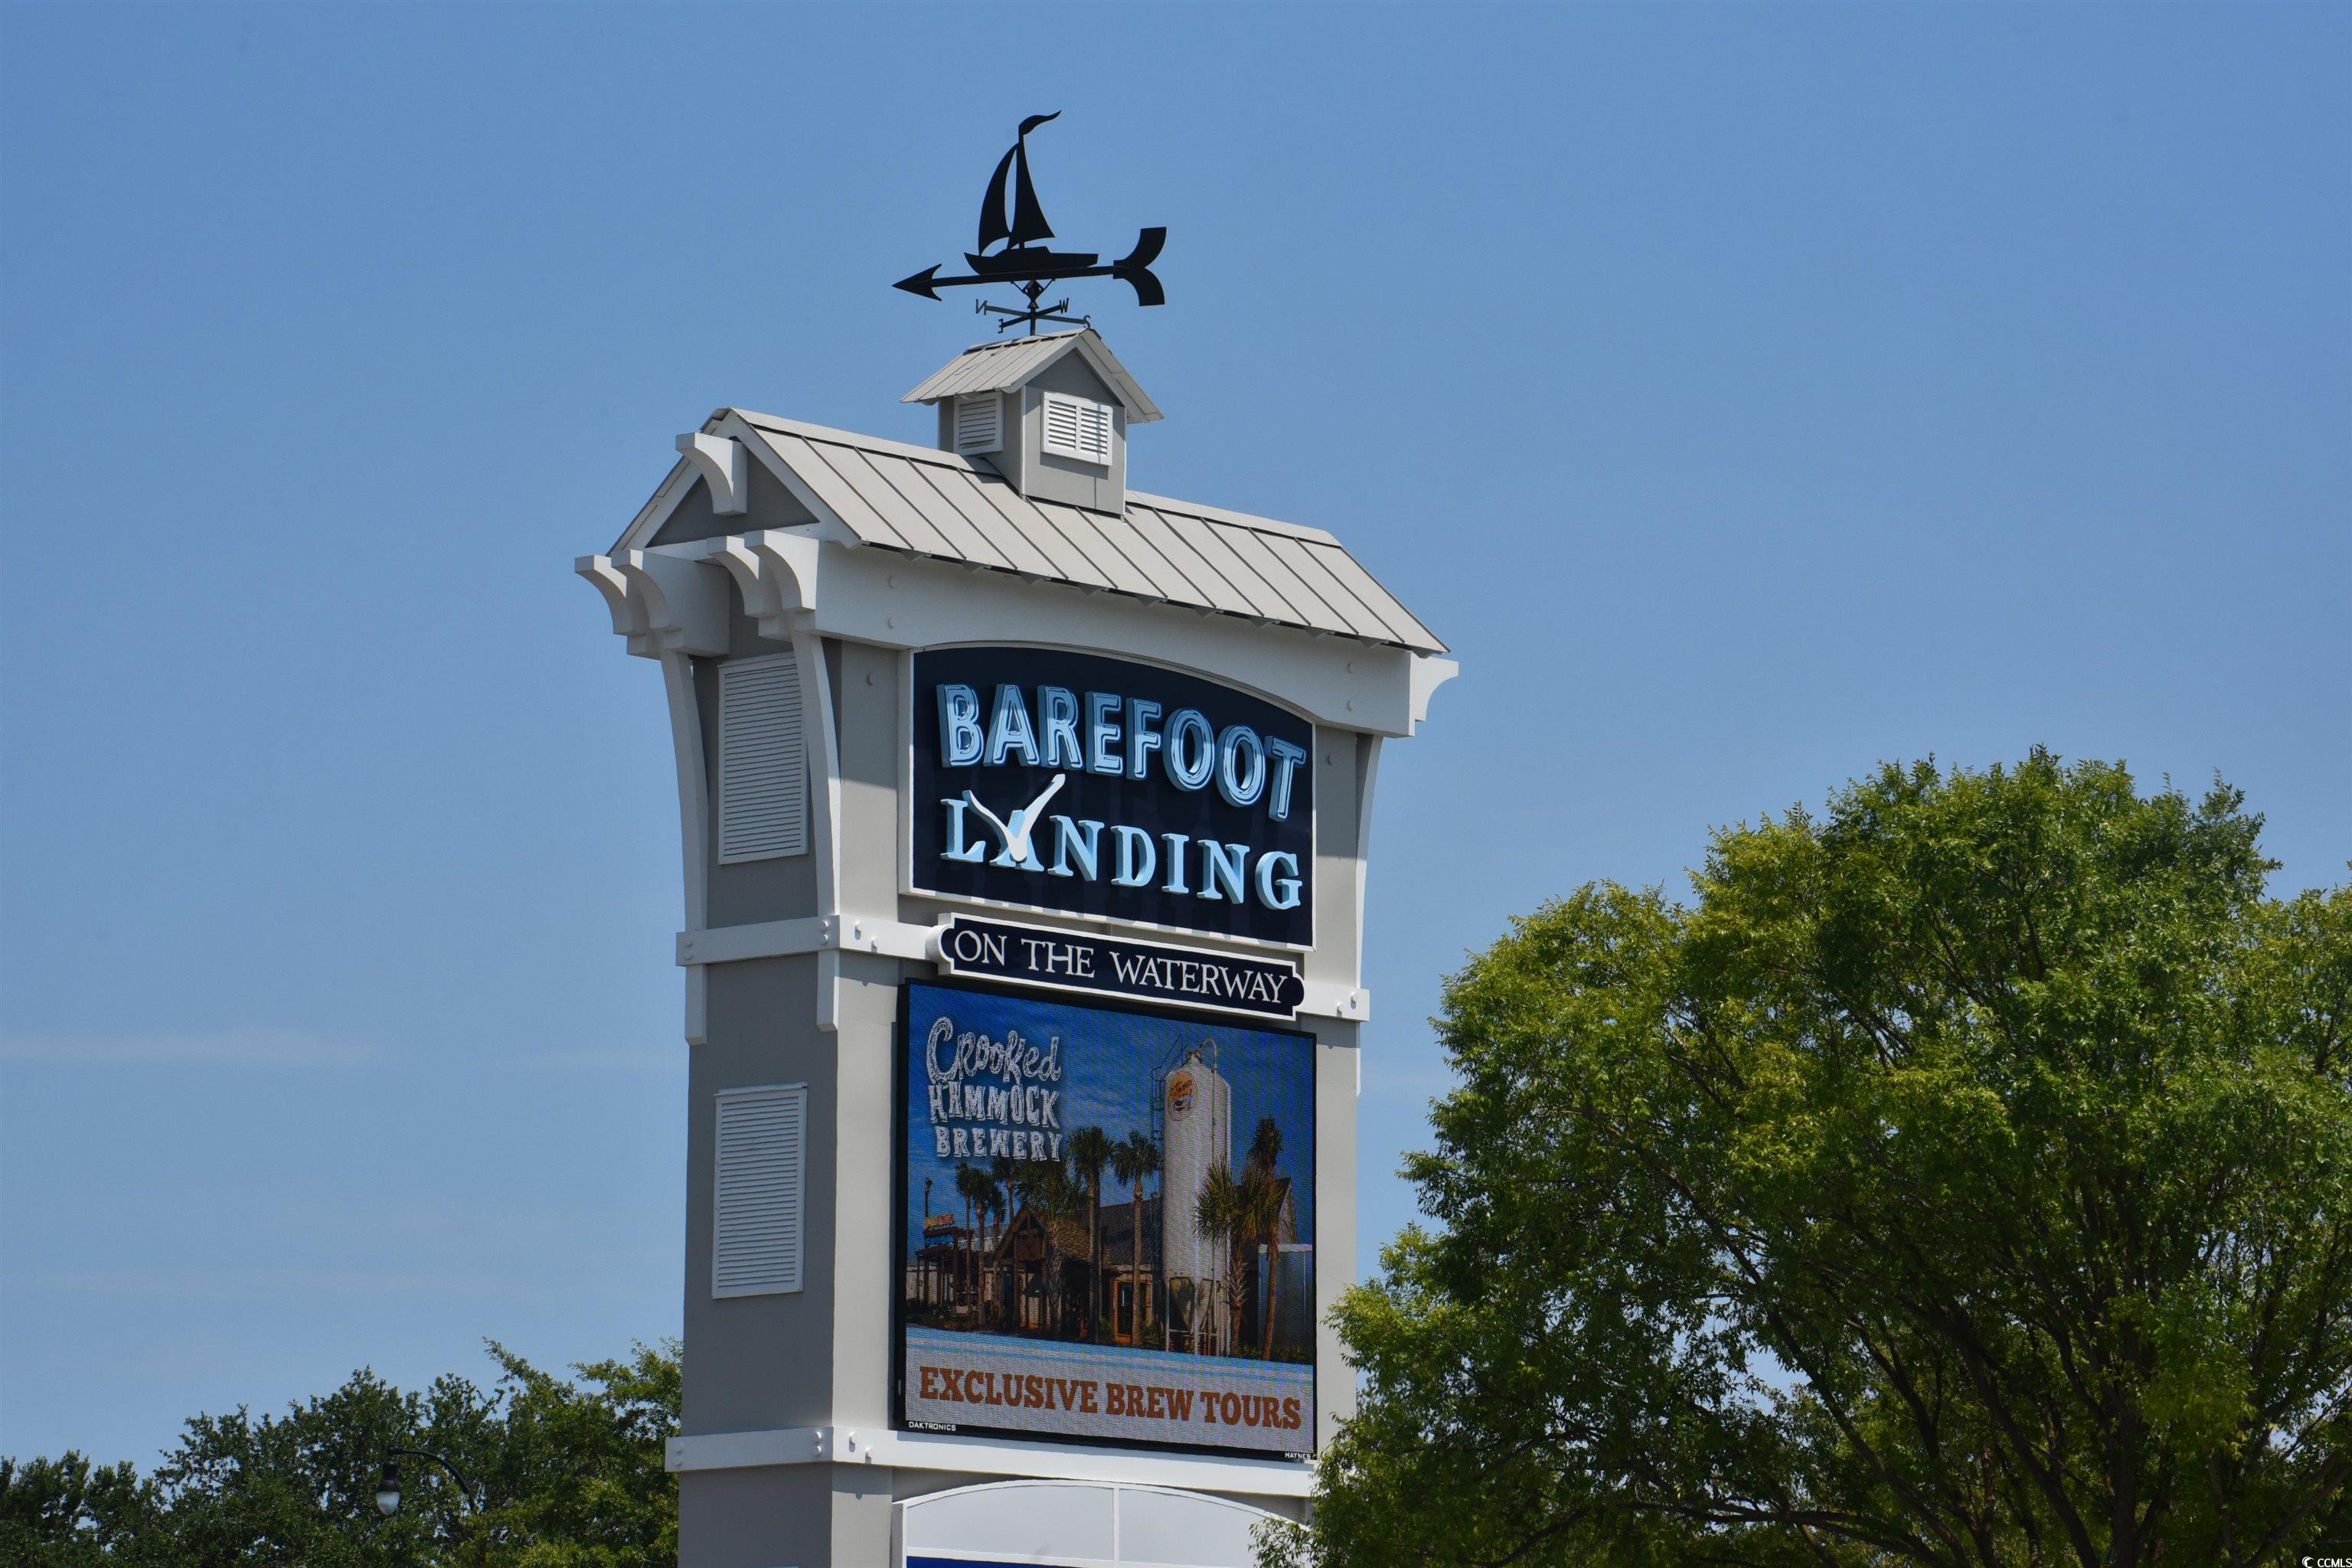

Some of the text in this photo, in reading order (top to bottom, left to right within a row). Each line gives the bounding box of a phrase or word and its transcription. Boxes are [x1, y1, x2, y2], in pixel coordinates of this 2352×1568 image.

[936, 683, 1306, 822] BAREFOOT
[939, 798, 1302, 910] LANDING
[955, 929, 1289, 1004] ON THE WATERWAY
[926, 1016, 1061, 1084] Crooked
[928, 1080, 1060, 1129] HAMMOCK
[935, 1125, 1062, 1162] BREWERY
[909, 1421, 956, 1432] DAKTRONICS
[920, 1366, 1302, 1430] EXCLUSIVE BREW TOURS
[1285, 1452, 1312, 1460] HAYNES
